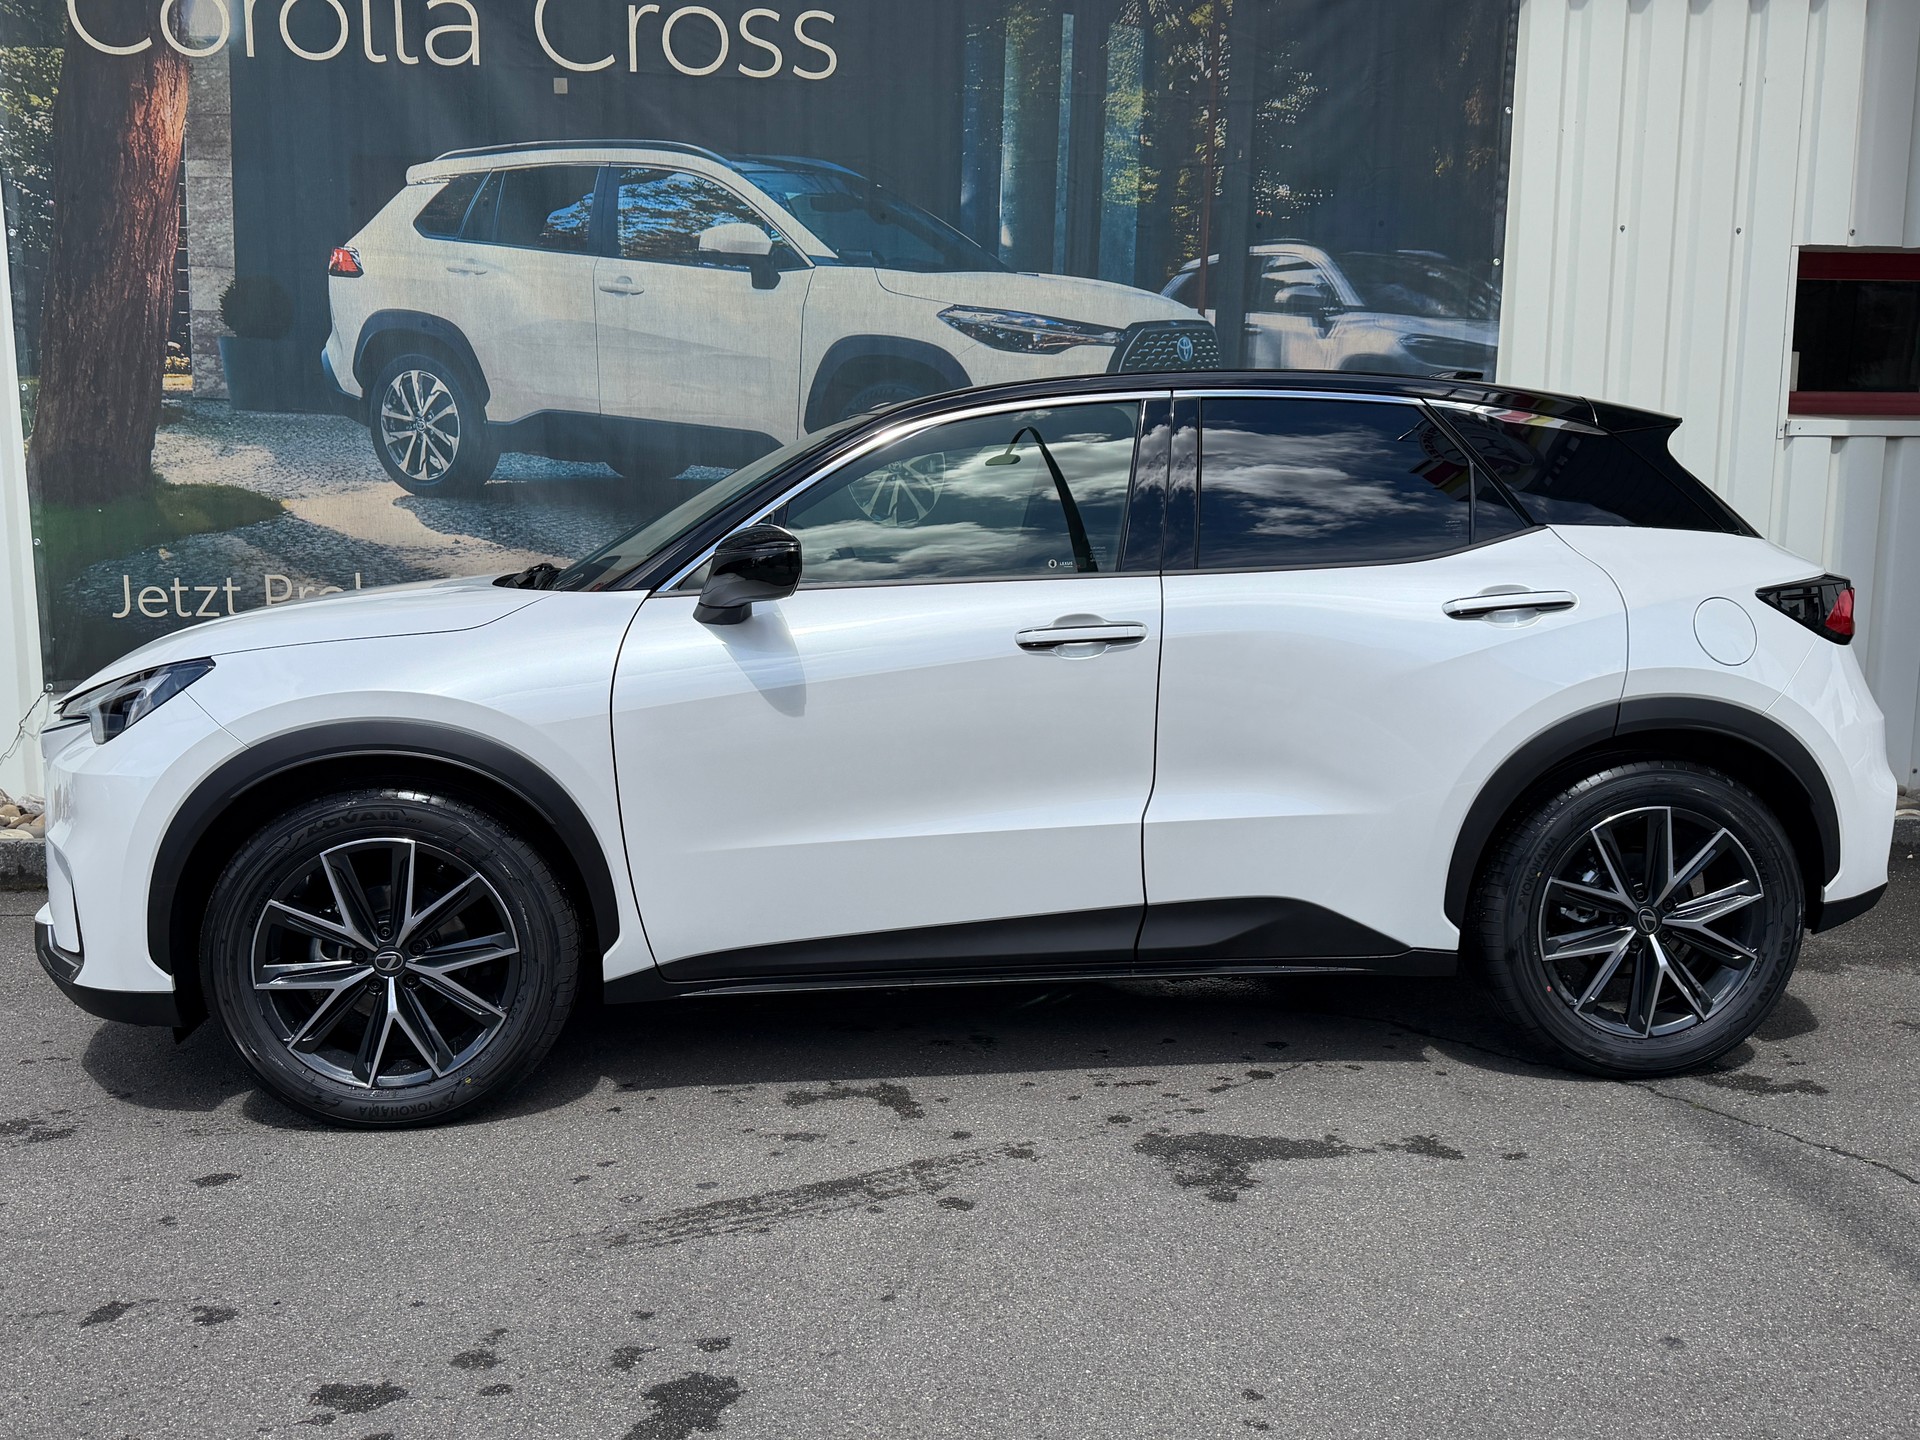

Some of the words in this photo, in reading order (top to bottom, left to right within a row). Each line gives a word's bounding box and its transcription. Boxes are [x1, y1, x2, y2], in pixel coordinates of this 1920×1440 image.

[66, 0, 480, 66] Corolla
[534, 0, 838, 80] Cross
[112, 574, 241, 619] Jetzt
[306, 811, 401, 839] ADVAN
[1520, 836, 1560, 898] YOKOHAMA
[358, 1101, 437, 1118] YOKOHAMA
